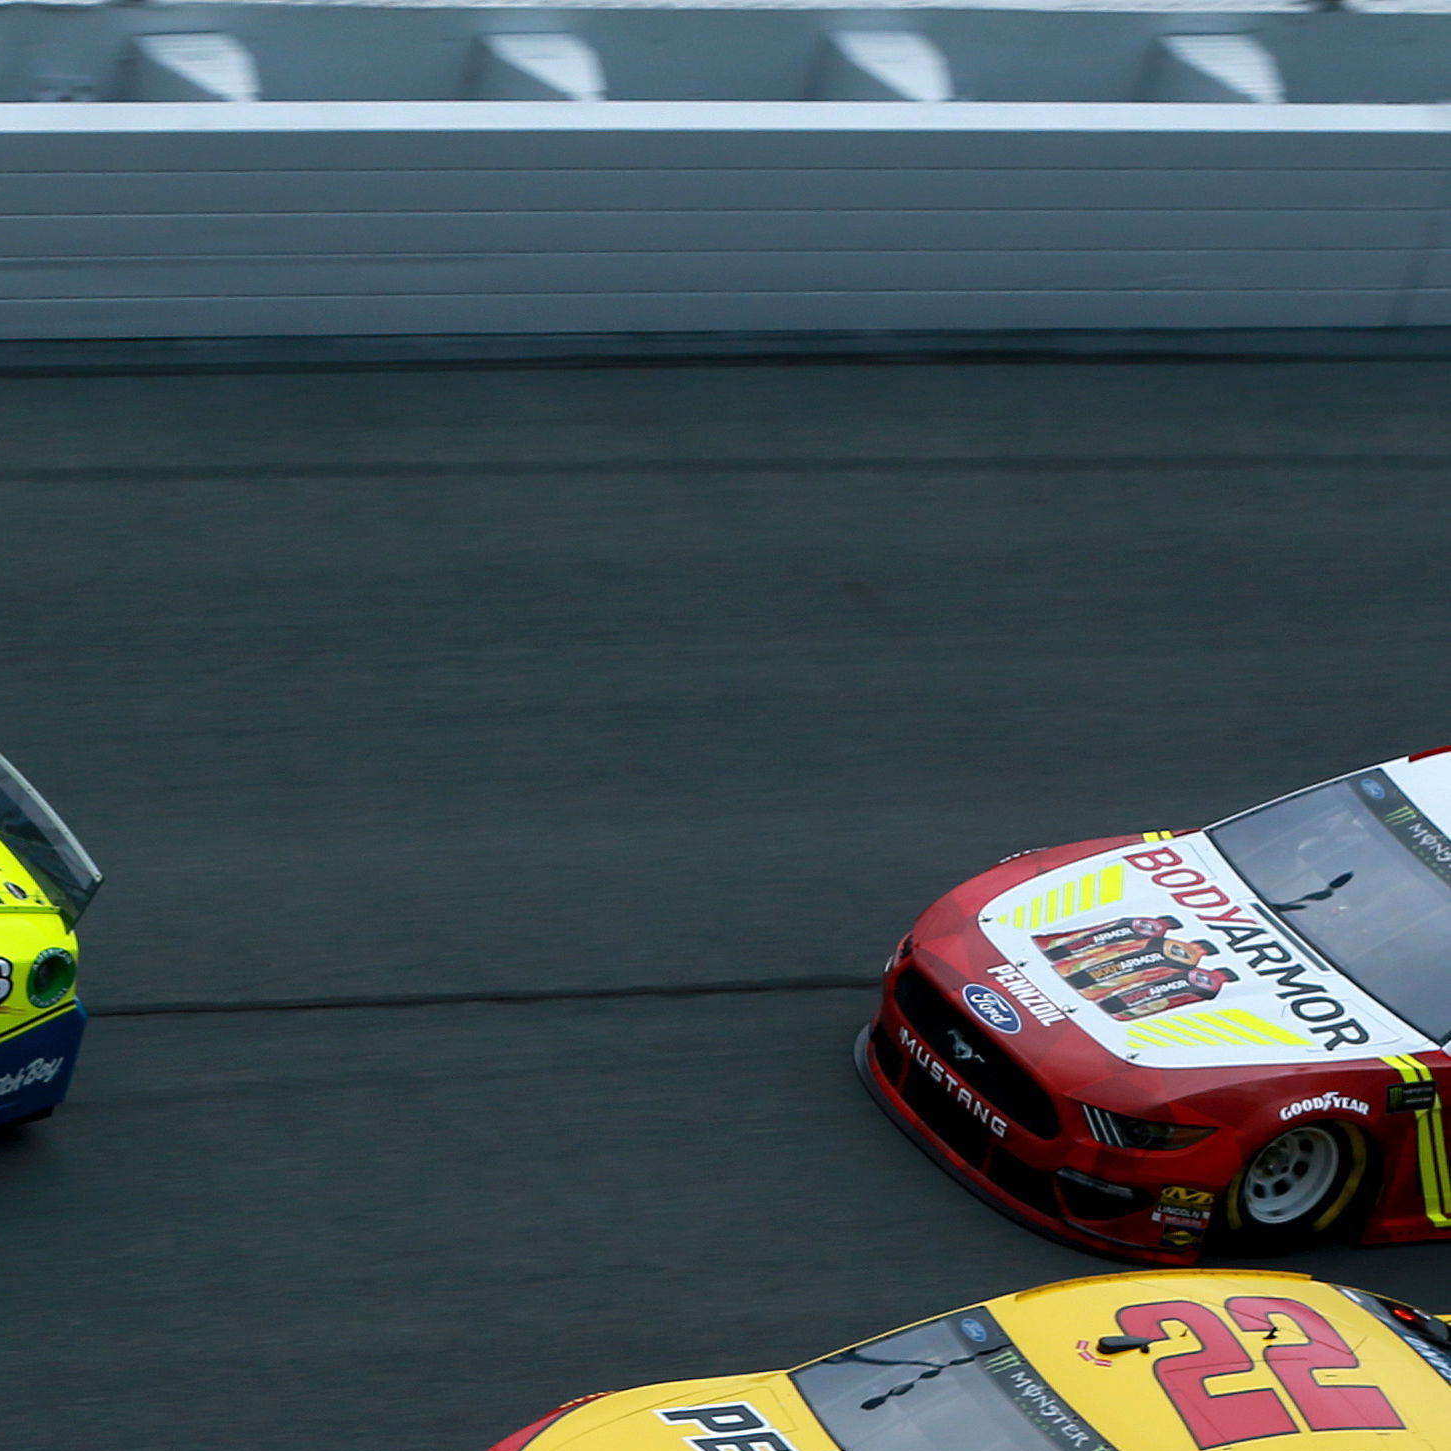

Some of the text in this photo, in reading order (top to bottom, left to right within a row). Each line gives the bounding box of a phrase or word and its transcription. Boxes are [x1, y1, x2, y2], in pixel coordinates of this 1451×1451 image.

[1121, 846, 1371, 1051] BODYARMOR
[969, 992, 1013, 1025] Ford
[986, 964, 1066, 1027] PENNZOIL
[900, 1027, 1009, 1138] MUSTANG
[1279, 1090, 1371, 1121] GOODYEAR
[1157, 1205, 1202, 1219] LINCOLN
[1114, 1296, 1407, 1450] 22
[1010, 1371, 1090, 1447] MONSTER
